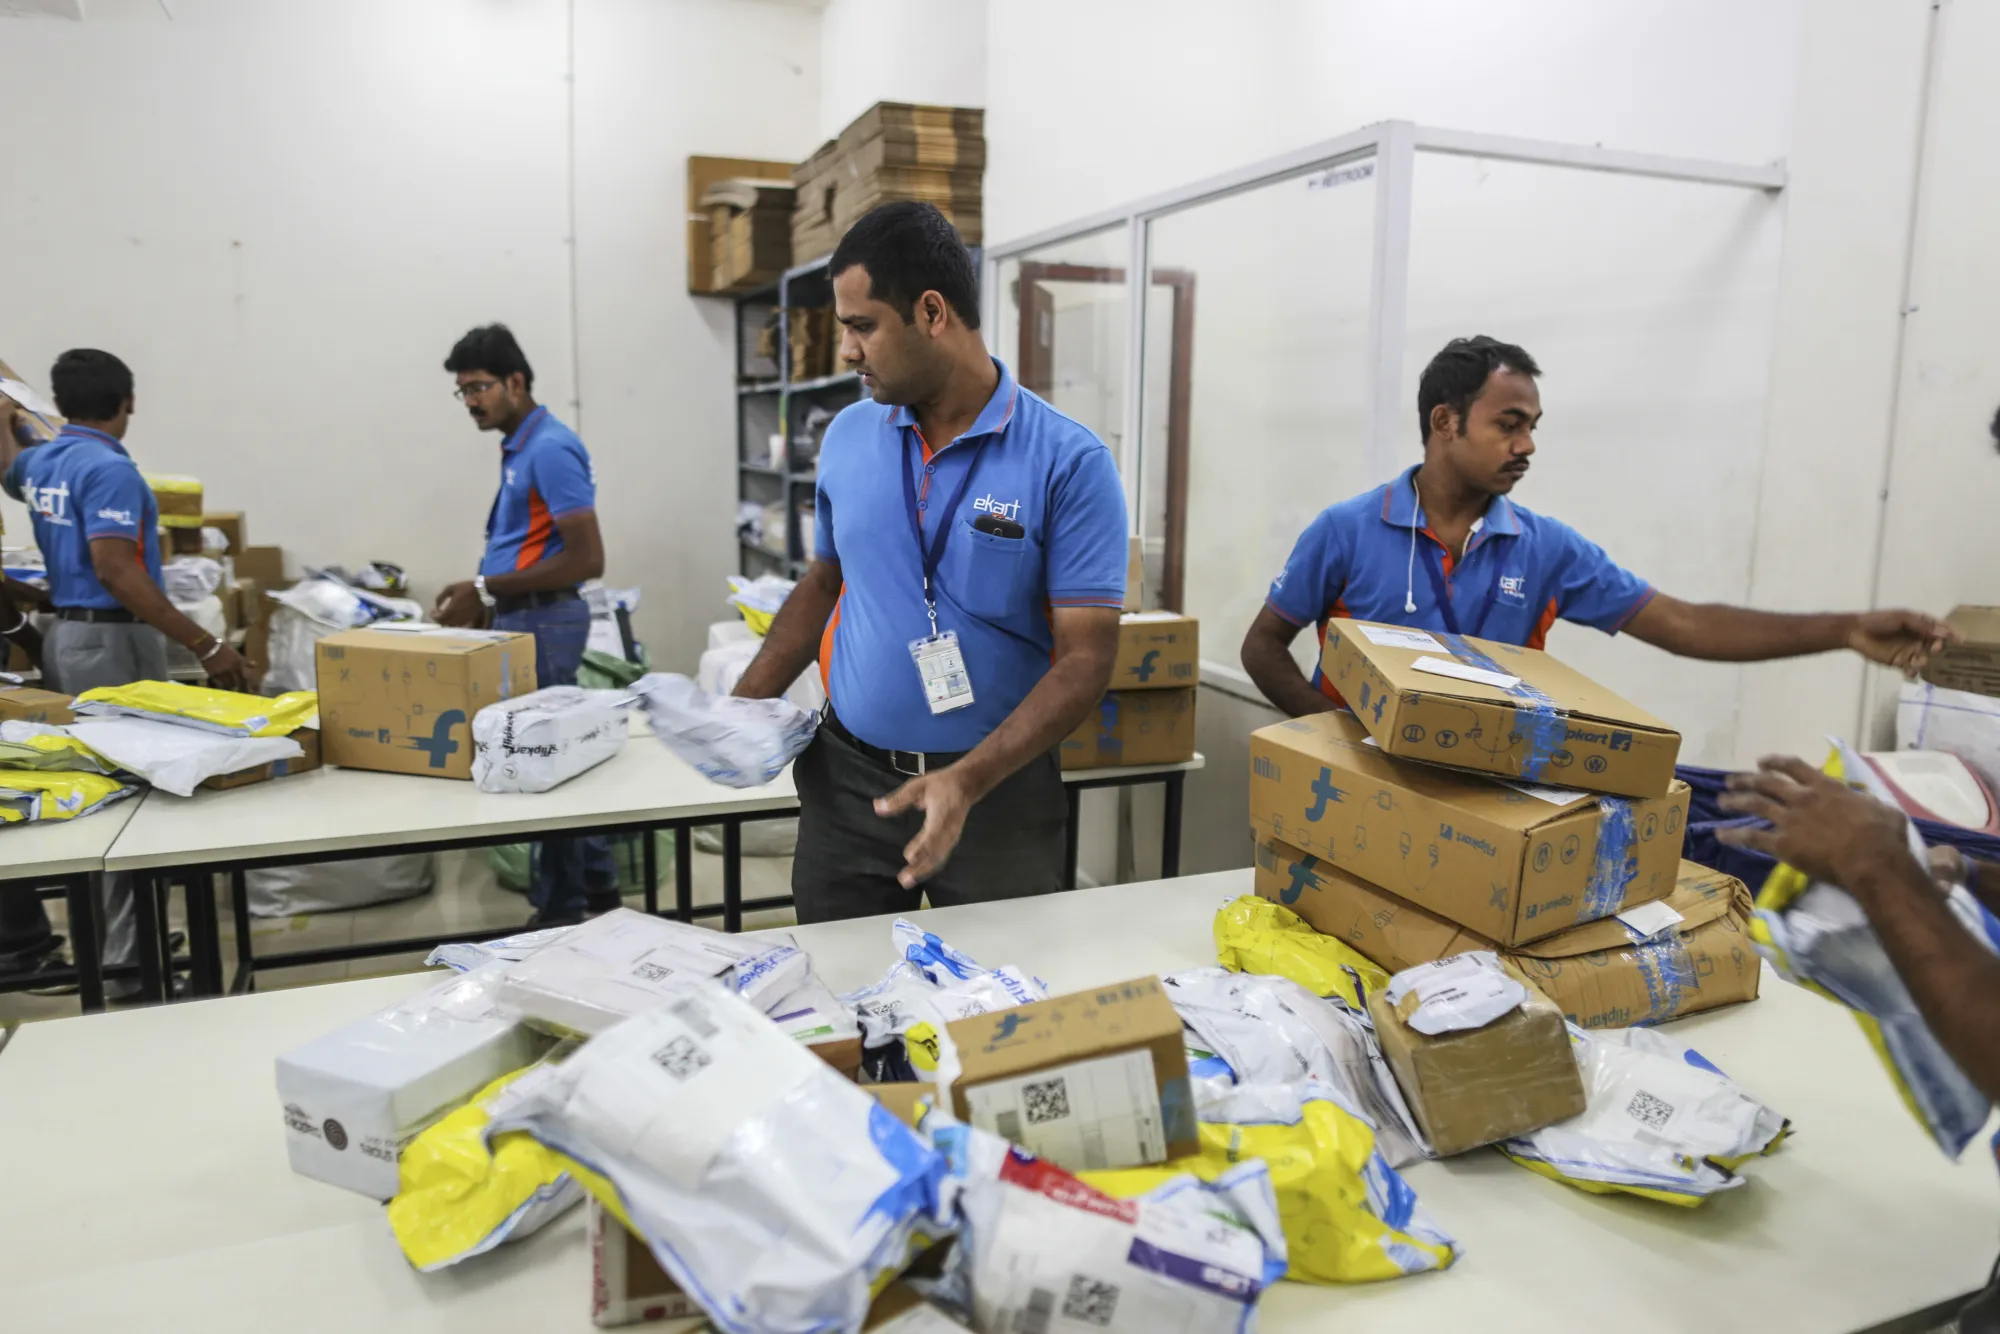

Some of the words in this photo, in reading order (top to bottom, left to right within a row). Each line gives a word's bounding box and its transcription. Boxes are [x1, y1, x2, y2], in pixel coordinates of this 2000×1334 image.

[20, 478, 71, 518] kart
[972, 493, 1022, 520] ekart
[1582, 1006, 1631, 1030] Flipkart
